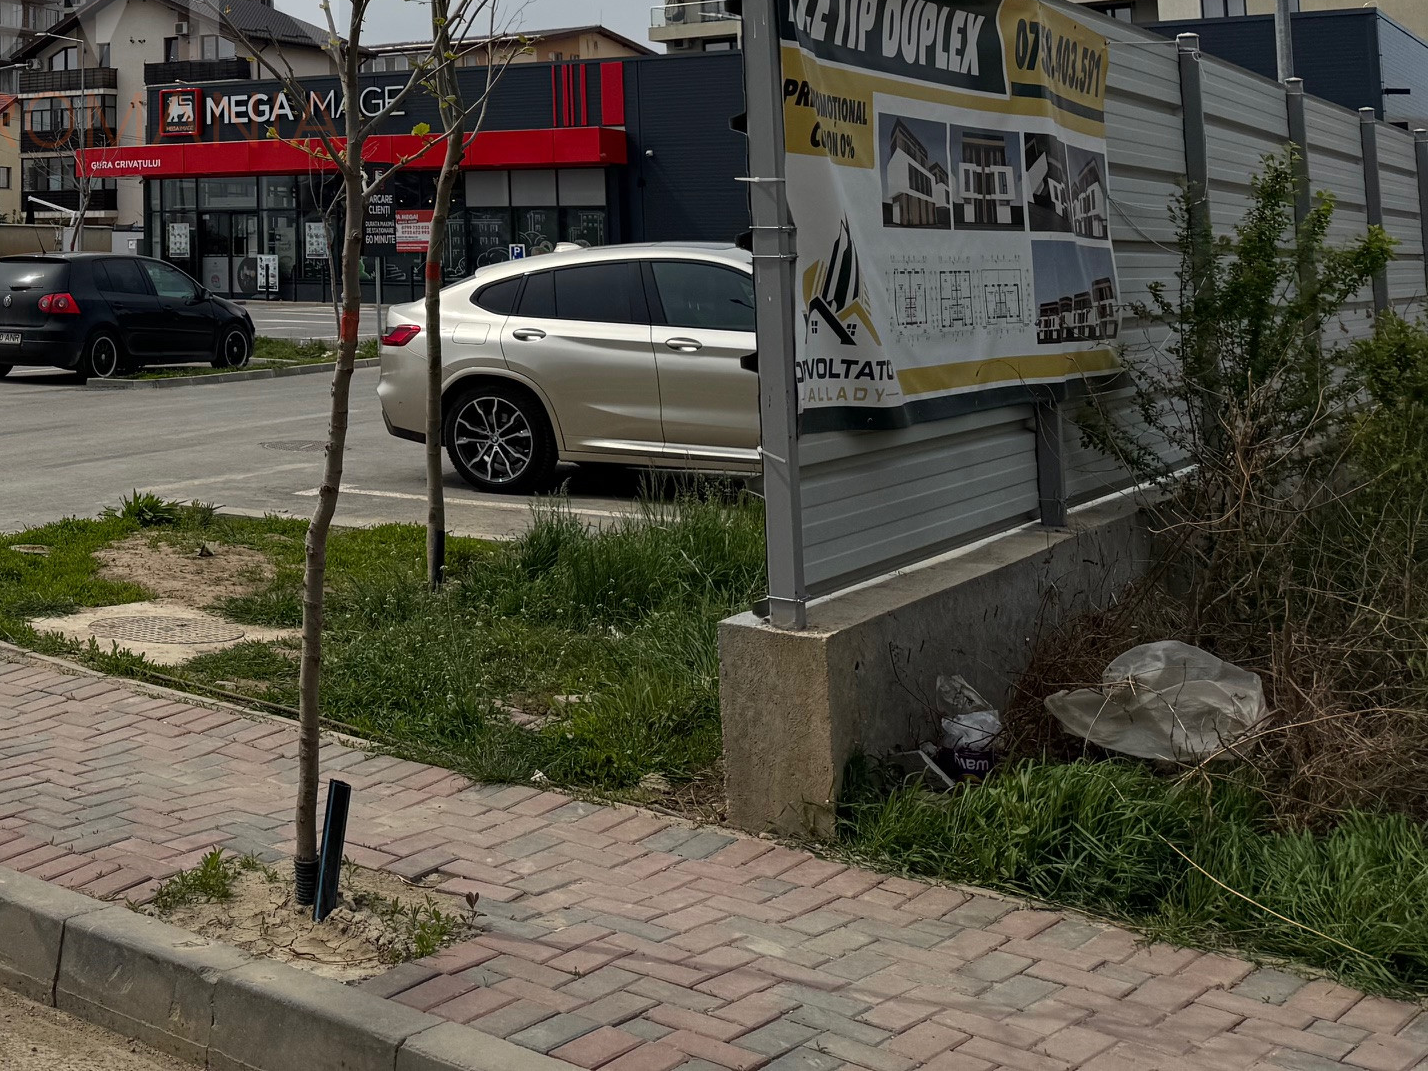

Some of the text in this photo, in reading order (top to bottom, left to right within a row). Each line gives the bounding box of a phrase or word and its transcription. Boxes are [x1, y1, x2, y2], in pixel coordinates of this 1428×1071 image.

[206, 92, 294, 124] MEGA
[840, 133, 855, 159] 0%
[114, 159, 160, 170] CRIVAȚULUI
[368, 195, 393, 204] ARCARE
[368, 205, 390, 217] CLIENȚI
[366, 235, 373, 243] 60
[374, 235, 396, 243] MINUTE
[514, 247, 520, 256] P
